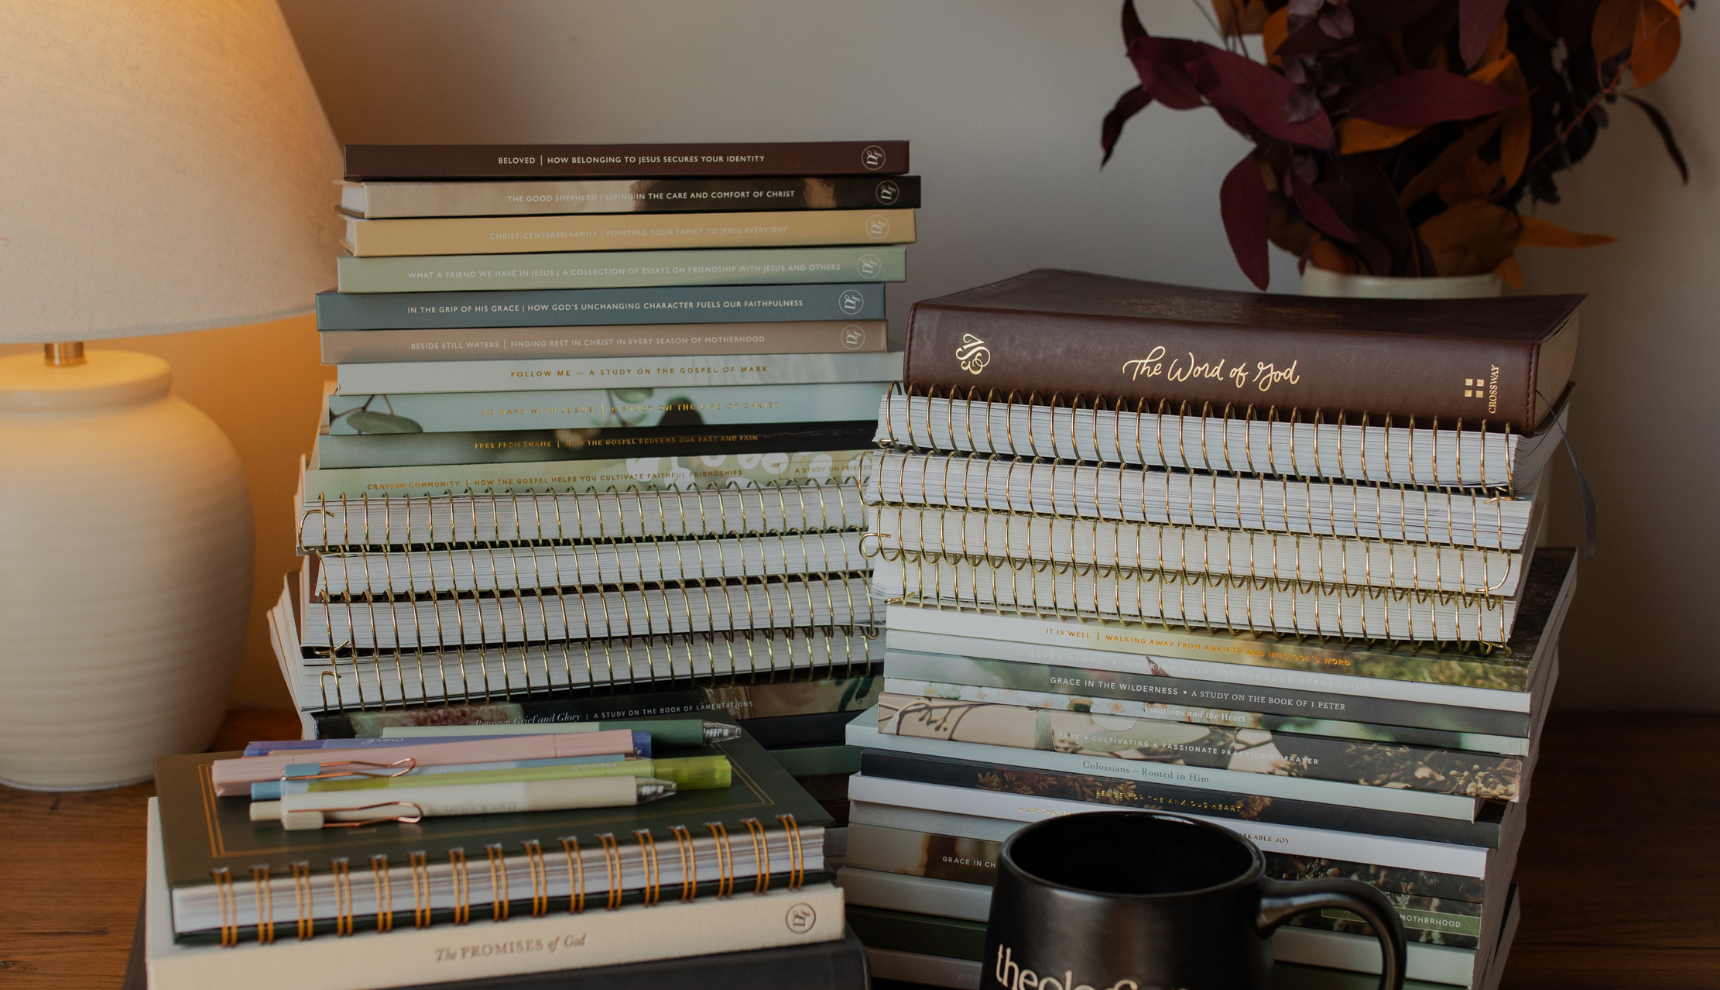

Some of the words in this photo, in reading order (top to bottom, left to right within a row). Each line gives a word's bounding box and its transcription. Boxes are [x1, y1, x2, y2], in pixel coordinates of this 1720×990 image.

[638, 156, 661, 164] JESUS
[490, 231, 567, 240] CHRIST-CENTERED
[606, 229, 648, 237] POINTING
[676, 228, 704, 236] FAMILY
[720, 227, 742, 236] JESUS
[408, 271, 434, 279] WHAT
[531, 270, 554, 278] JESUS
[571, 268, 625, 276] COLLECTION
[642, 267, 670, 275] ESSAYS
[688, 266, 736, 274] FRIENDSHIP
[763, 264, 786, 273] JESUS
[809, 263, 841, 271] OTHERS
[744, 299, 804, 307] FAITHFULNESS
[411, 342, 439, 350] BESIDE
[466, 341, 499, 349] WATERS
[511, 340, 547, 348] FINDING
[629, 338, 653, 346] EVERY
[655, 337, 688, 345] SEASON
[704, 336, 765, 344] MOTHERHOOD
[1122, 345, 1166, 382] The
[1167, 352, 1225, 382] Word
[1229, 362, 1249, 389] of
[1252, 359, 1300, 392] God
[1488, 364, 1500, 415] CROSSWAY
[367, 482, 406, 491] CRAVING
[409, 480, 460, 489] COMMUNITY
[474, 478, 494, 486] HOW
[516, 476, 548, 484] GOSPEL
[552, 475, 577, 483] HELPS
[580, 474, 597, 482] YOU
[600, 473, 644, 481] CULTIVATE
[647, 471, 686, 479] FAITHFUL
[689, 469, 743, 478] FRIENDSHIPS
[1068, 630, 1090, 638] WELL
[1105, 634, 1146, 644] WALKING
[1149, 638, 1174, 647] AWAY
[1178, 641, 1201, 650] FROM
[1204, 644, 1243, 654] ANXIETY
[1246, 649, 1265, 657] AND
[1268, 651, 1290, 659] INTO
[1323, 657, 1350, 666] WORD
[1050, 676, 1081, 686] GRACE
[1098, 681, 1116, 689] THE
[1119, 683, 1178, 695] WILDERNESS
[1199, 691, 1230, 700] STUDY
[1231, 694, 1245, 702] ON
[1248, 695, 1266, 704] THE
[1268, 697, 1293, 706] BOOK
[1296, 700, 1308, 708] OF
[1318, 702, 1346, 711] PETER
[557, 711, 582, 723] Glory
[601, 710, 626, 718] STUDY
[696, 700, 753, 710] LAMENTATIONS
[1145, 705, 1185, 716] Emotions
[1187, 709, 1203, 718] and
[1206, 711, 1219, 719] the
[1221, 713, 1246, 722] Heart
[1059, 732, 1080, 740] PRAY
[1092, 736, 1149, 747] CULTIVATING
[1162, 743, 1218, 754] PASSIONATE
[1221, 749, 1265, 759] PRACTICE
[1284, 755, 1319, 764] PRAYER
[1082, 760, 1130, 774] Colossians
[1141, 767, 1173, 779] Rooted
[1176, 771, 1186, 780] in
[1189, 772, 1209, 783] Him
[942, 855, 970, 865] GRACE
[973, 858, 982, 866] IN
[1400, 914, 1461, 928] MOTHERHOOD
[435, 947, 457, 961] The
[461, 938, 544, 959] PROMISES
[547, 935, 561, 953] of
[563, 933, 587, 948] God
